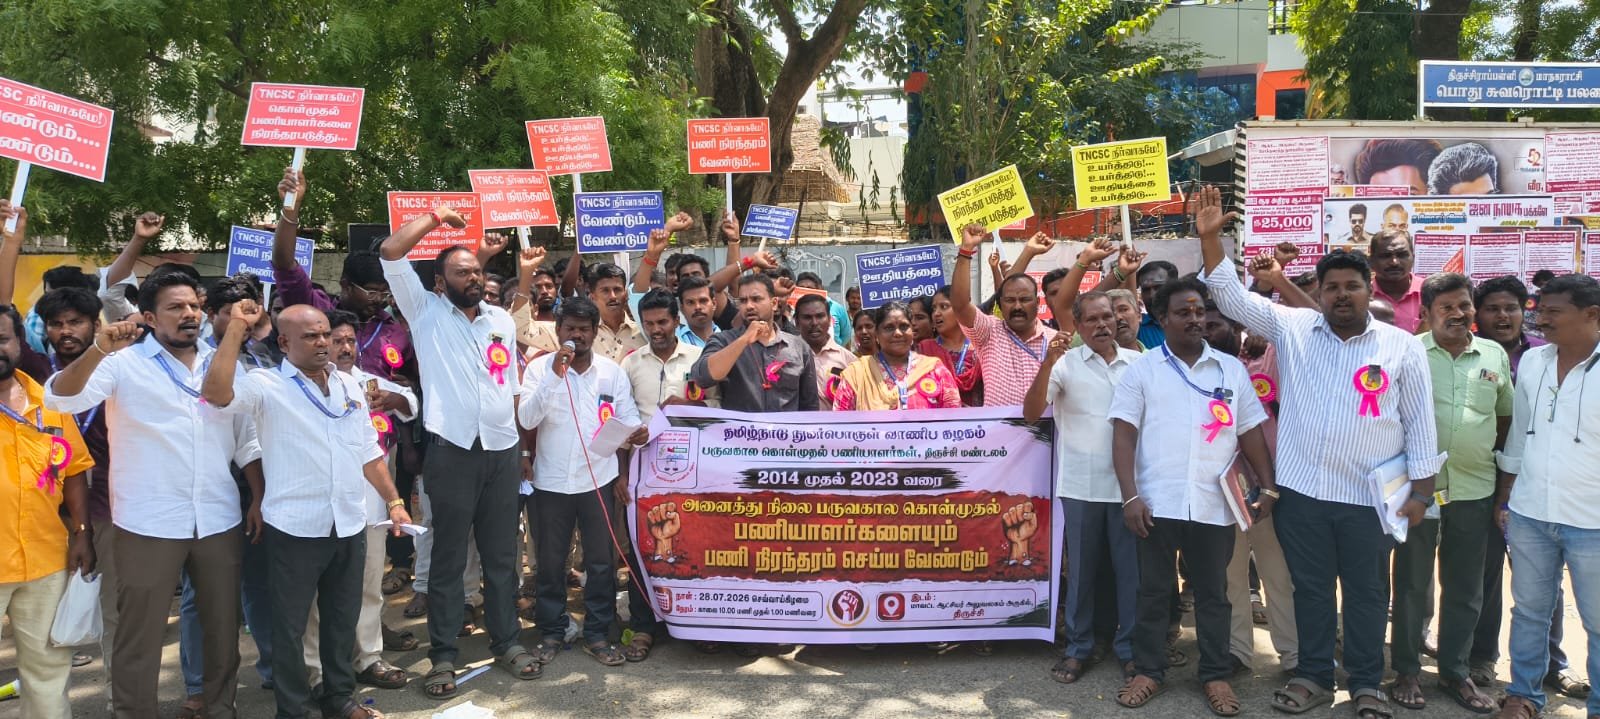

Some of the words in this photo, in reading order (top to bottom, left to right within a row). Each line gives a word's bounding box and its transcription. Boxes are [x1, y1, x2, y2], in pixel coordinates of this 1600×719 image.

[1447, 67, 1516, 83] திருச்சிராப்பள்ளி
[1535, 70, 1583, 83] மாநகராட்சி
[259, 88, 295, 100] TNCSC
[296, 89, 356, 103] நிர்வாகமே!
[1436, 84, 1482, 102] பொது
[1486, 84, 1563, 102] சுவரொட்டி
[24, 95, 103, 125] நிர்வாகமே!
[268, 103, 340, 117] கொள்முதல்
[0, 110, 100, 147] ண்டும்....
[251, 116, 352, 129] பணியாளர்களை
[532, 124, 559, 135] TNCSC
[693, 124, 720, 134] TNCSC
[722, 122, 764, 134] நிர்வாகமே!
[691, 137, 717, 150] பணி
[719, 136, 767, 151] நிரந்தரம்
[1079, 149, 1111, 161] TNCSC
[1112, 142, 1160, 160] நிர்வாகமே!
[699, 155, 760, 169] வேண்டும்!...
[1087, 159, 1154, 172] உயர்த்திடு!...
[476, 176, 504, 185] TNCSC
[1088, 169, 1156, 183] உயர்த்திடு!...
[944, 188, 972, 206] TNCSC
[972, 170, 1014, 195] நிர்வாகமே!
[1089, 180, 1156, 193] ஊதியத்தை
[396, 198, 427, 208] TNCSC
[506, 188, 551, 203] நிரந்தரம்
[581, 197, 611, 208] TNCSC
[612, 195, 658, 209] நிர்வாகமே!
[952, 198, 985, 221] நிரந்தர
[985, 184, 1017, 205] படுத்து!
[580, 212, 660, 229] வேண்டும்....
[988, 204, 1025, 223] படுத்து...
[238, 232, 265, 244] TNCSC
[233, 246, 259, 258] பணி
[862, 256, 891, 267] TNCSC
[892, 249, 937, 266] நிர்வாகமே!
[862, 267, 941, 284] ஊதியத்தை
[869, 282, 938, 301] உயர்த்திடு!
[723, 425, 788, 442] தமிழ்நாடு
[792, 428, 880, 443] நுகர்பொருள்
[884, 427, 938, 441] வாணிப
[942, 425, 986, 442] கழகம்
[702, 447, 759, 457] பருவகால
[762, 444, 828, 459] கொள்முதல்
[831, 444, 921, 458] பணியாளர்கள்,
[924, 446, 958, 460] திருச்சி
[960, 446, 1008, 457] மண்டலம்
[758, 471, 799, 485] 2014
[804, 471, 845, 487] முதல்
[850, 471, 898, 486] 2023
[903, 476, 943, 488] வரை
[681, 497, 763, 516] அனைத்து
[767, 497, 813, 516] நிலை
[816, 500, 899, 517] பருவகால
[902, 497, 1001, 517] கொள்முதல்
[734, 518, 958, 547] பணியாளர்களையும்
[704, 546, 748, 568] பணி
[755, 546, 836, 574] நிரந்தரம்
[842, 547, 899, 569] செய்ய
[904, 546, 988, 572] வேண்டும்
[675, 591, 692, 602] நாள்
[699, 592, 750, 602] 28.07.2026
[911, 592, 931, 602] இடம்
[675, 604, 693, 614] நேரம்
[718, 606, 735, 614] 10.00
[737, 607, 752, 615] மணி
[752, 606, 769, 617] முதல்
[936, 601, 963, 609] ஆட்சியர்
[953, 608, 985, 619] திருச்சி
